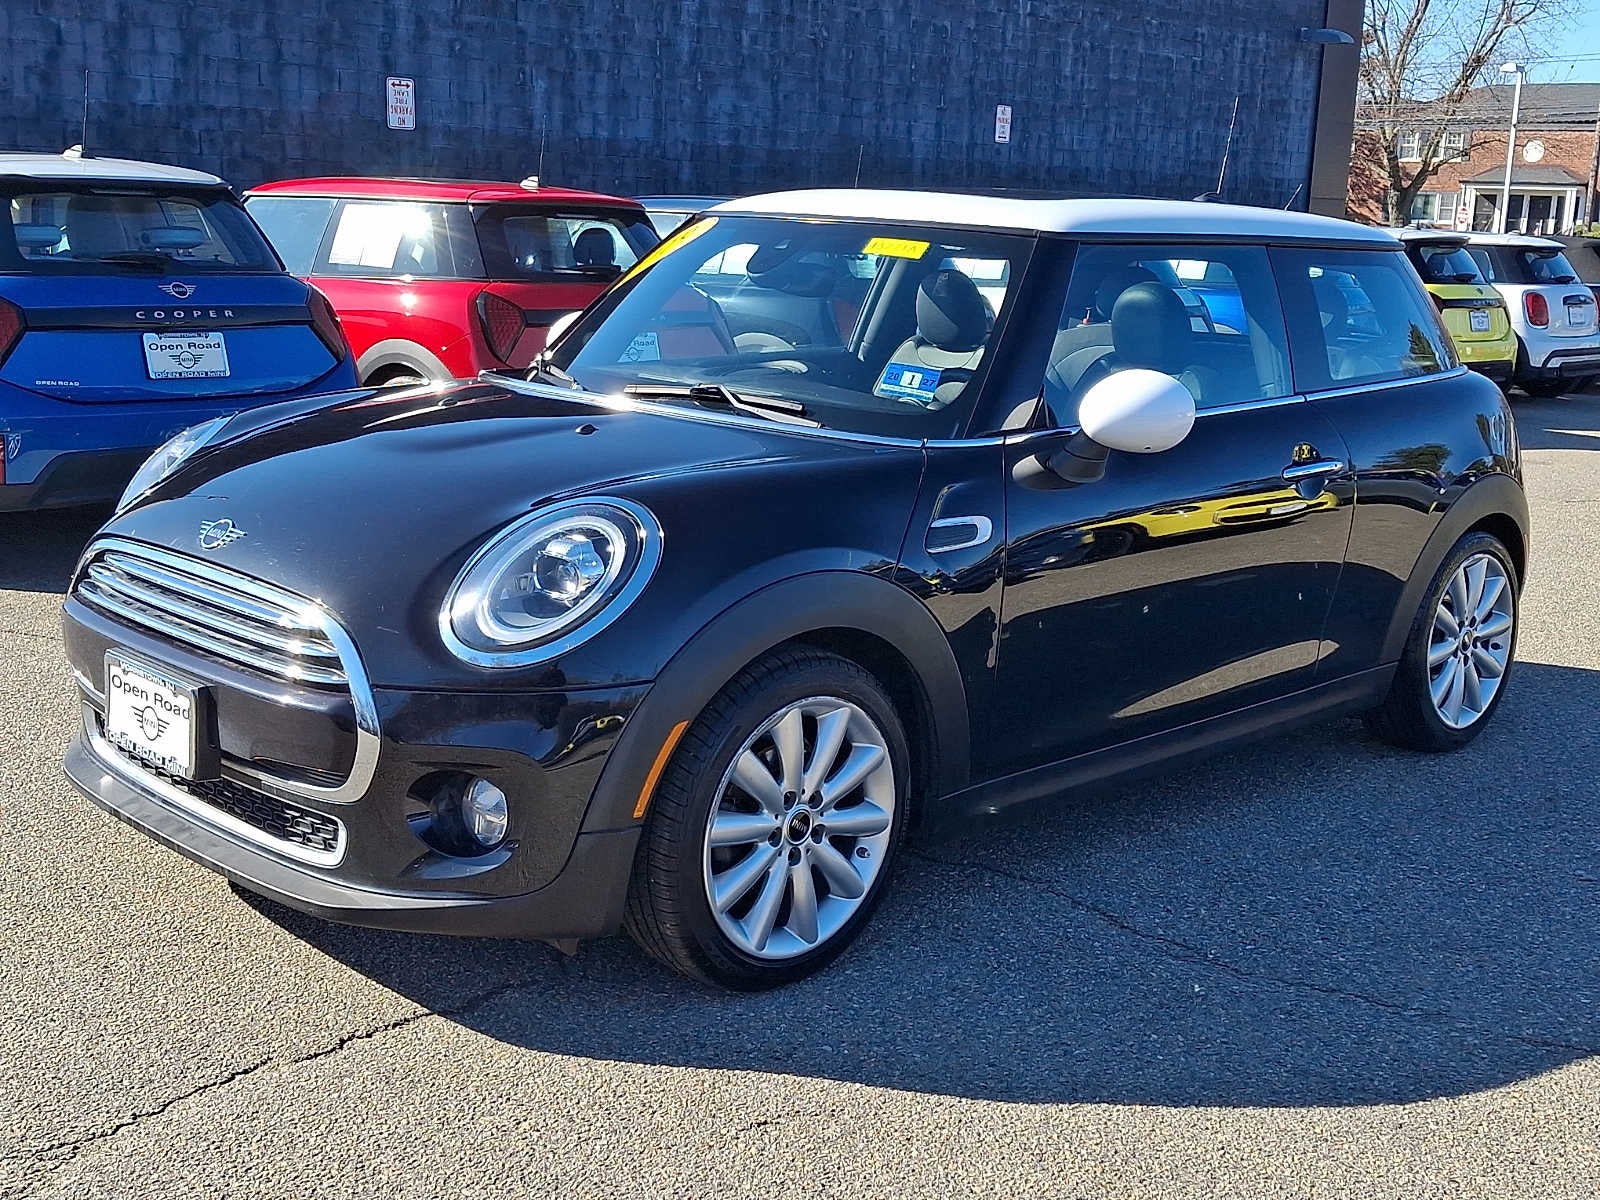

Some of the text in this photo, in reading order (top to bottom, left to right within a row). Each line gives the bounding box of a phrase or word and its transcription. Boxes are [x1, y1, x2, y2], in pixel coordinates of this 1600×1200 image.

[135, 310, 234, 318] COOPER
[148, 341, 221, 352] Open Road
[887, 372, 937, 387] 20 1 27
[111, 674, 190, 720] Open Road
